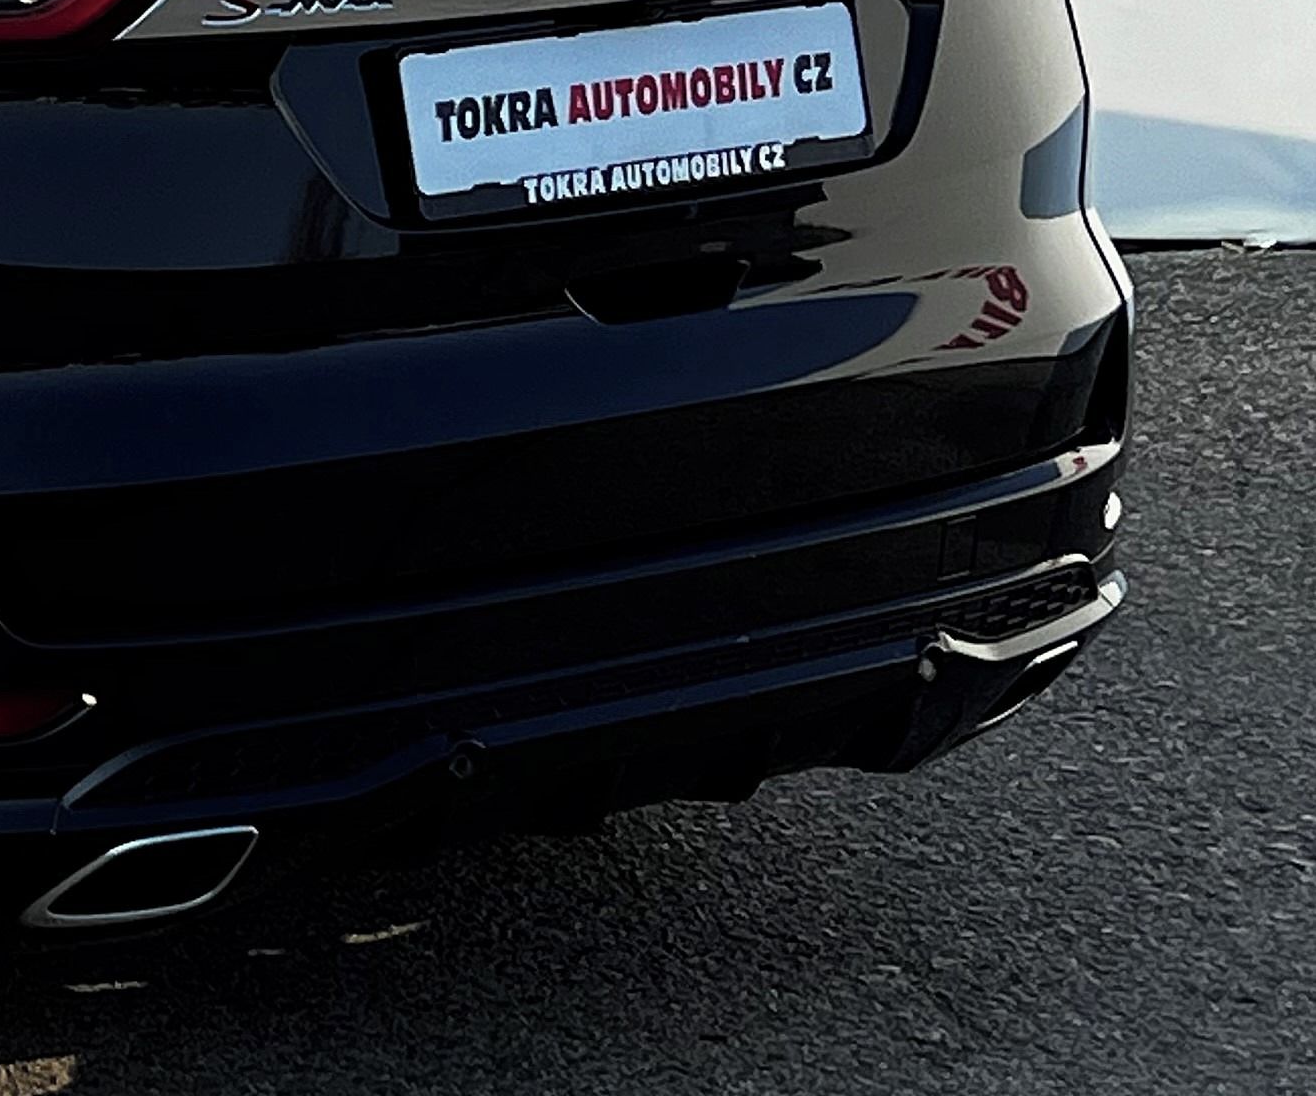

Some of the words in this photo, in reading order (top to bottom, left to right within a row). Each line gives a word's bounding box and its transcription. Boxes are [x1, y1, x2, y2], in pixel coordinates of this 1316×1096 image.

[435, 88, 558, 142] TOKRA
[569, 58, 784, 125] AUTOMOBILY
[793, 52, 833, 94] CZ
[524, 168, 605, 204] TOKRA
[610, 148, 752, 192] AUTOMOBILY
[758, 143, 786, 171] CZ
